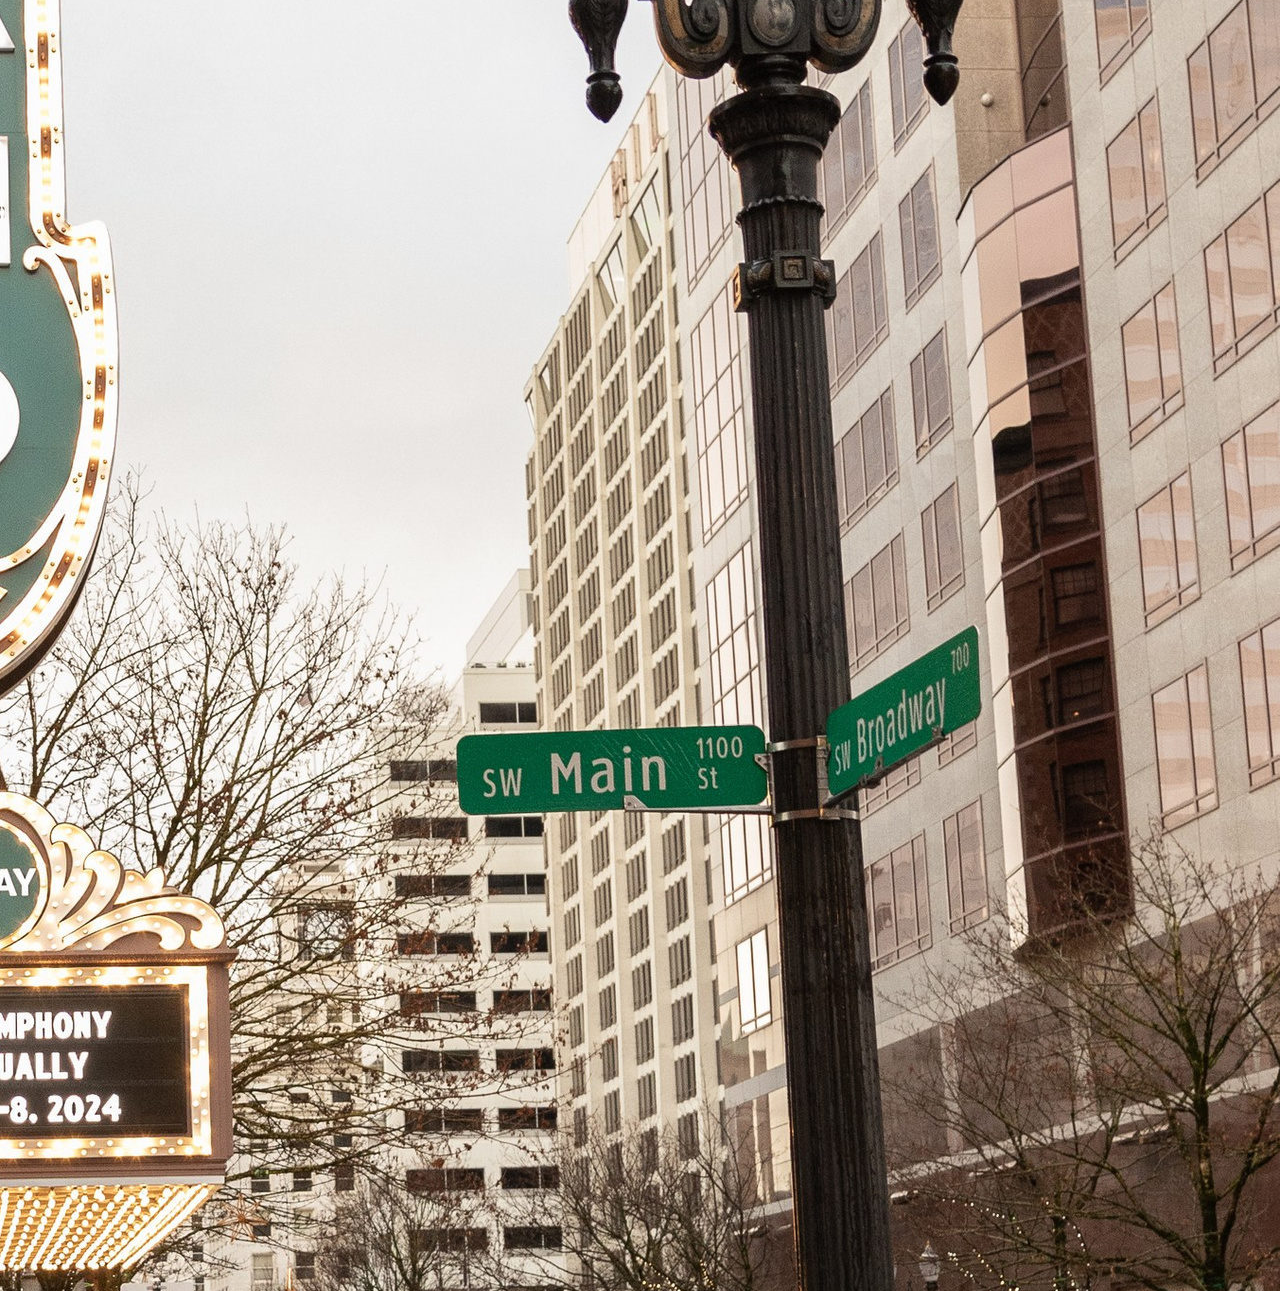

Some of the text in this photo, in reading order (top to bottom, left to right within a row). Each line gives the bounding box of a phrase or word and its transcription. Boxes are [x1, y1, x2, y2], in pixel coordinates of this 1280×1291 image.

[950, 641, 969, 676] 700
[834, 675, 948, 776] SW Broadway
[695, 735, 744, 759] 1100
[482, 745, 667, 798] SW Main
[698, 767, 719, 790] St
[47, 1093, 122, 1123] 2024
